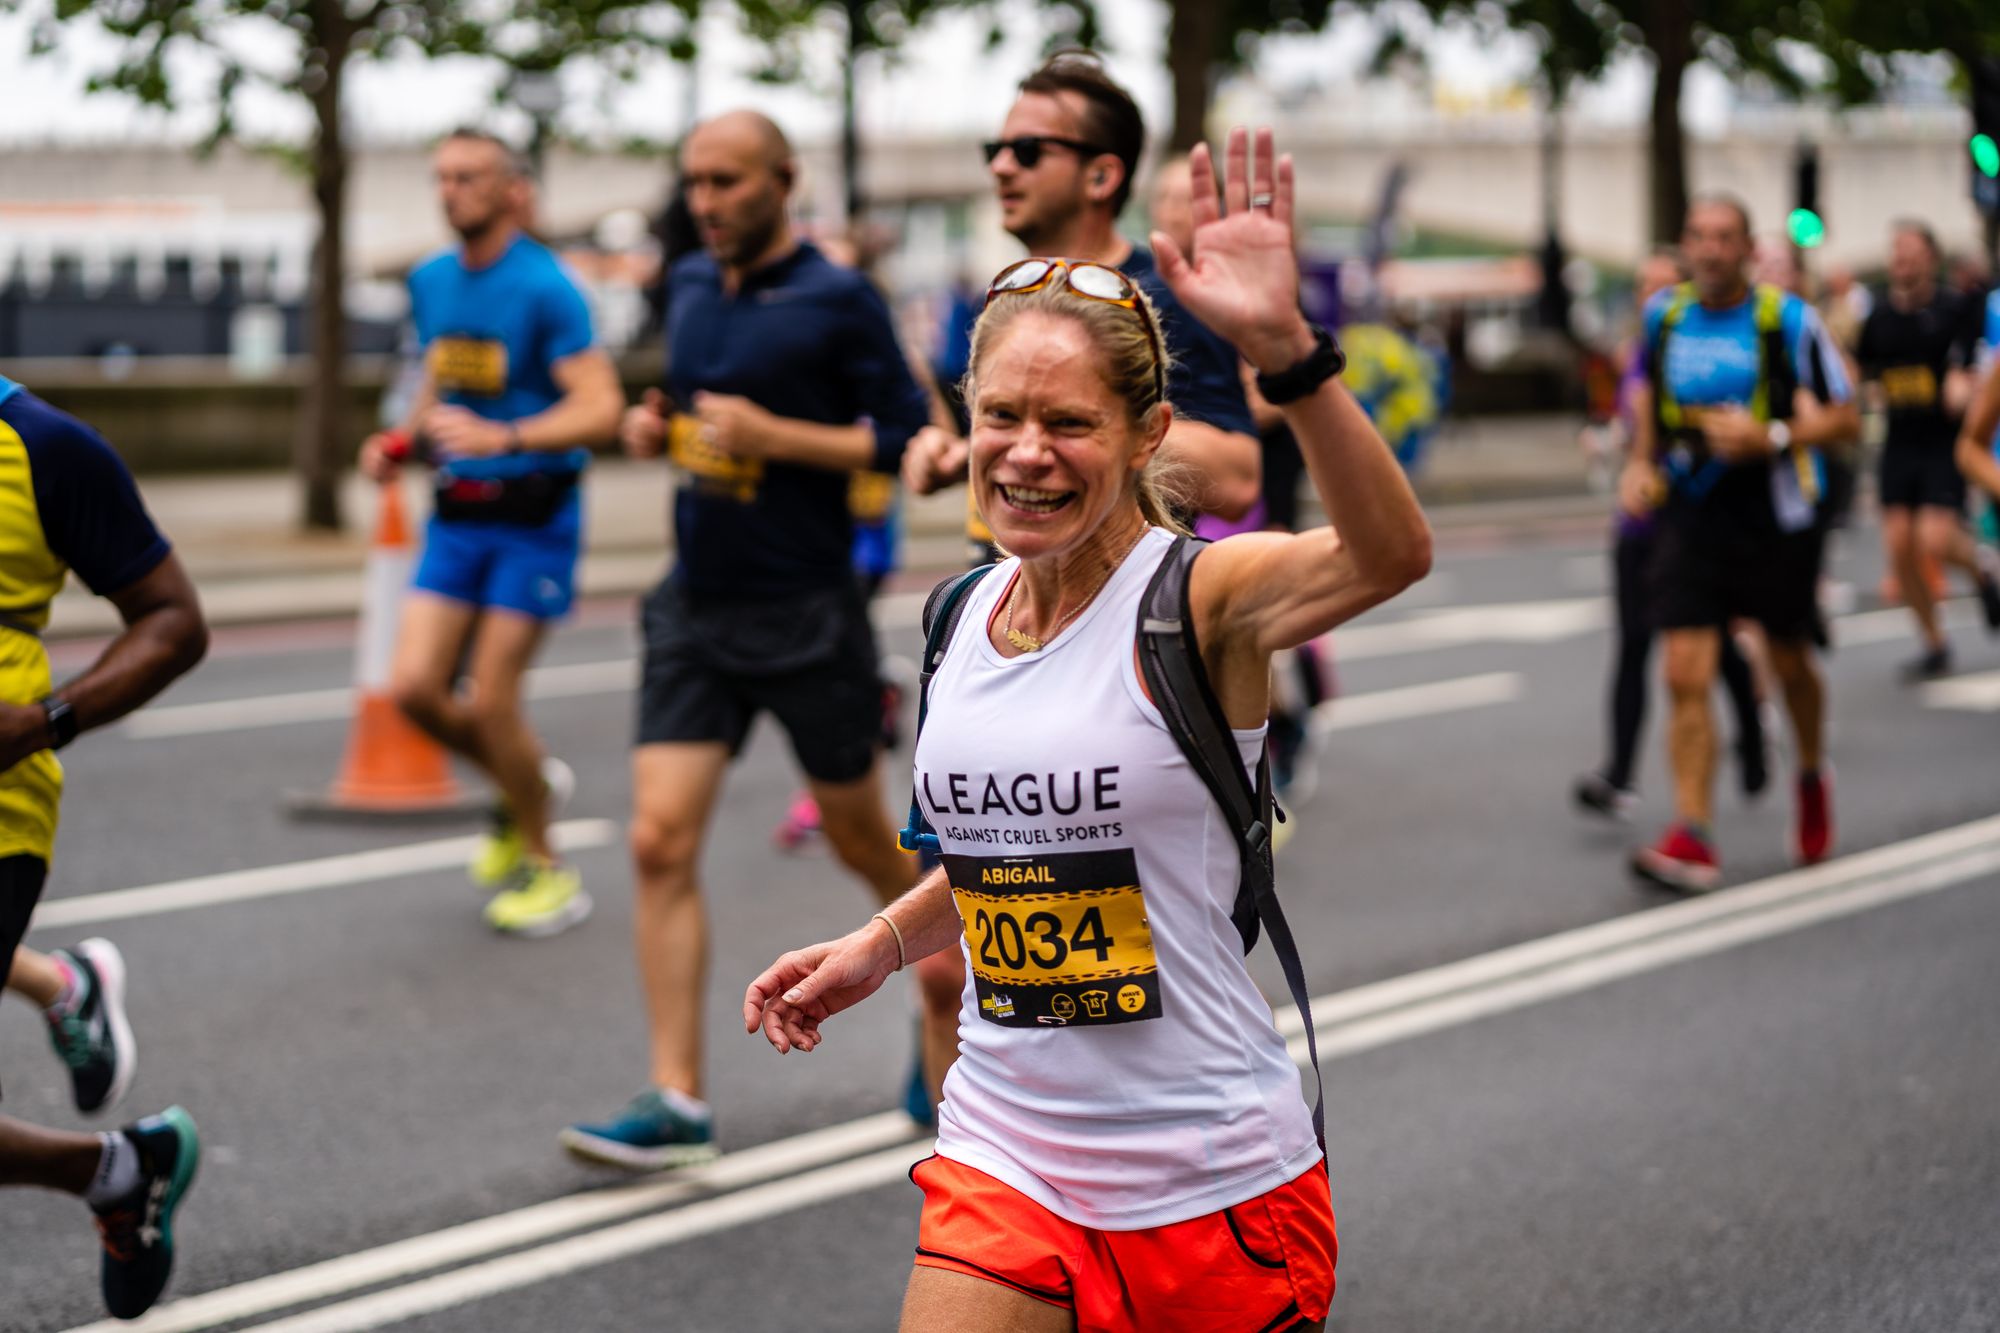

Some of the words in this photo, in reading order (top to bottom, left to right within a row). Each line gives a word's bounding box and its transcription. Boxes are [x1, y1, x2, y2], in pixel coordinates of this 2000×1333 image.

[923, 765, 1121, 817] LEAGUE
[945, 826, 1001, 844] AGAINST
[1003, 828, 1052, 845] CRUEL
[1056, 822, 1123, 843] SPORTS
[981, 865, 1056, 885] ABIGAIL
[975, 906, 1115, 970] 2034
[1121, 990, 1141, 998] WAVE
[1128, 997, 1137, 1008] 2
